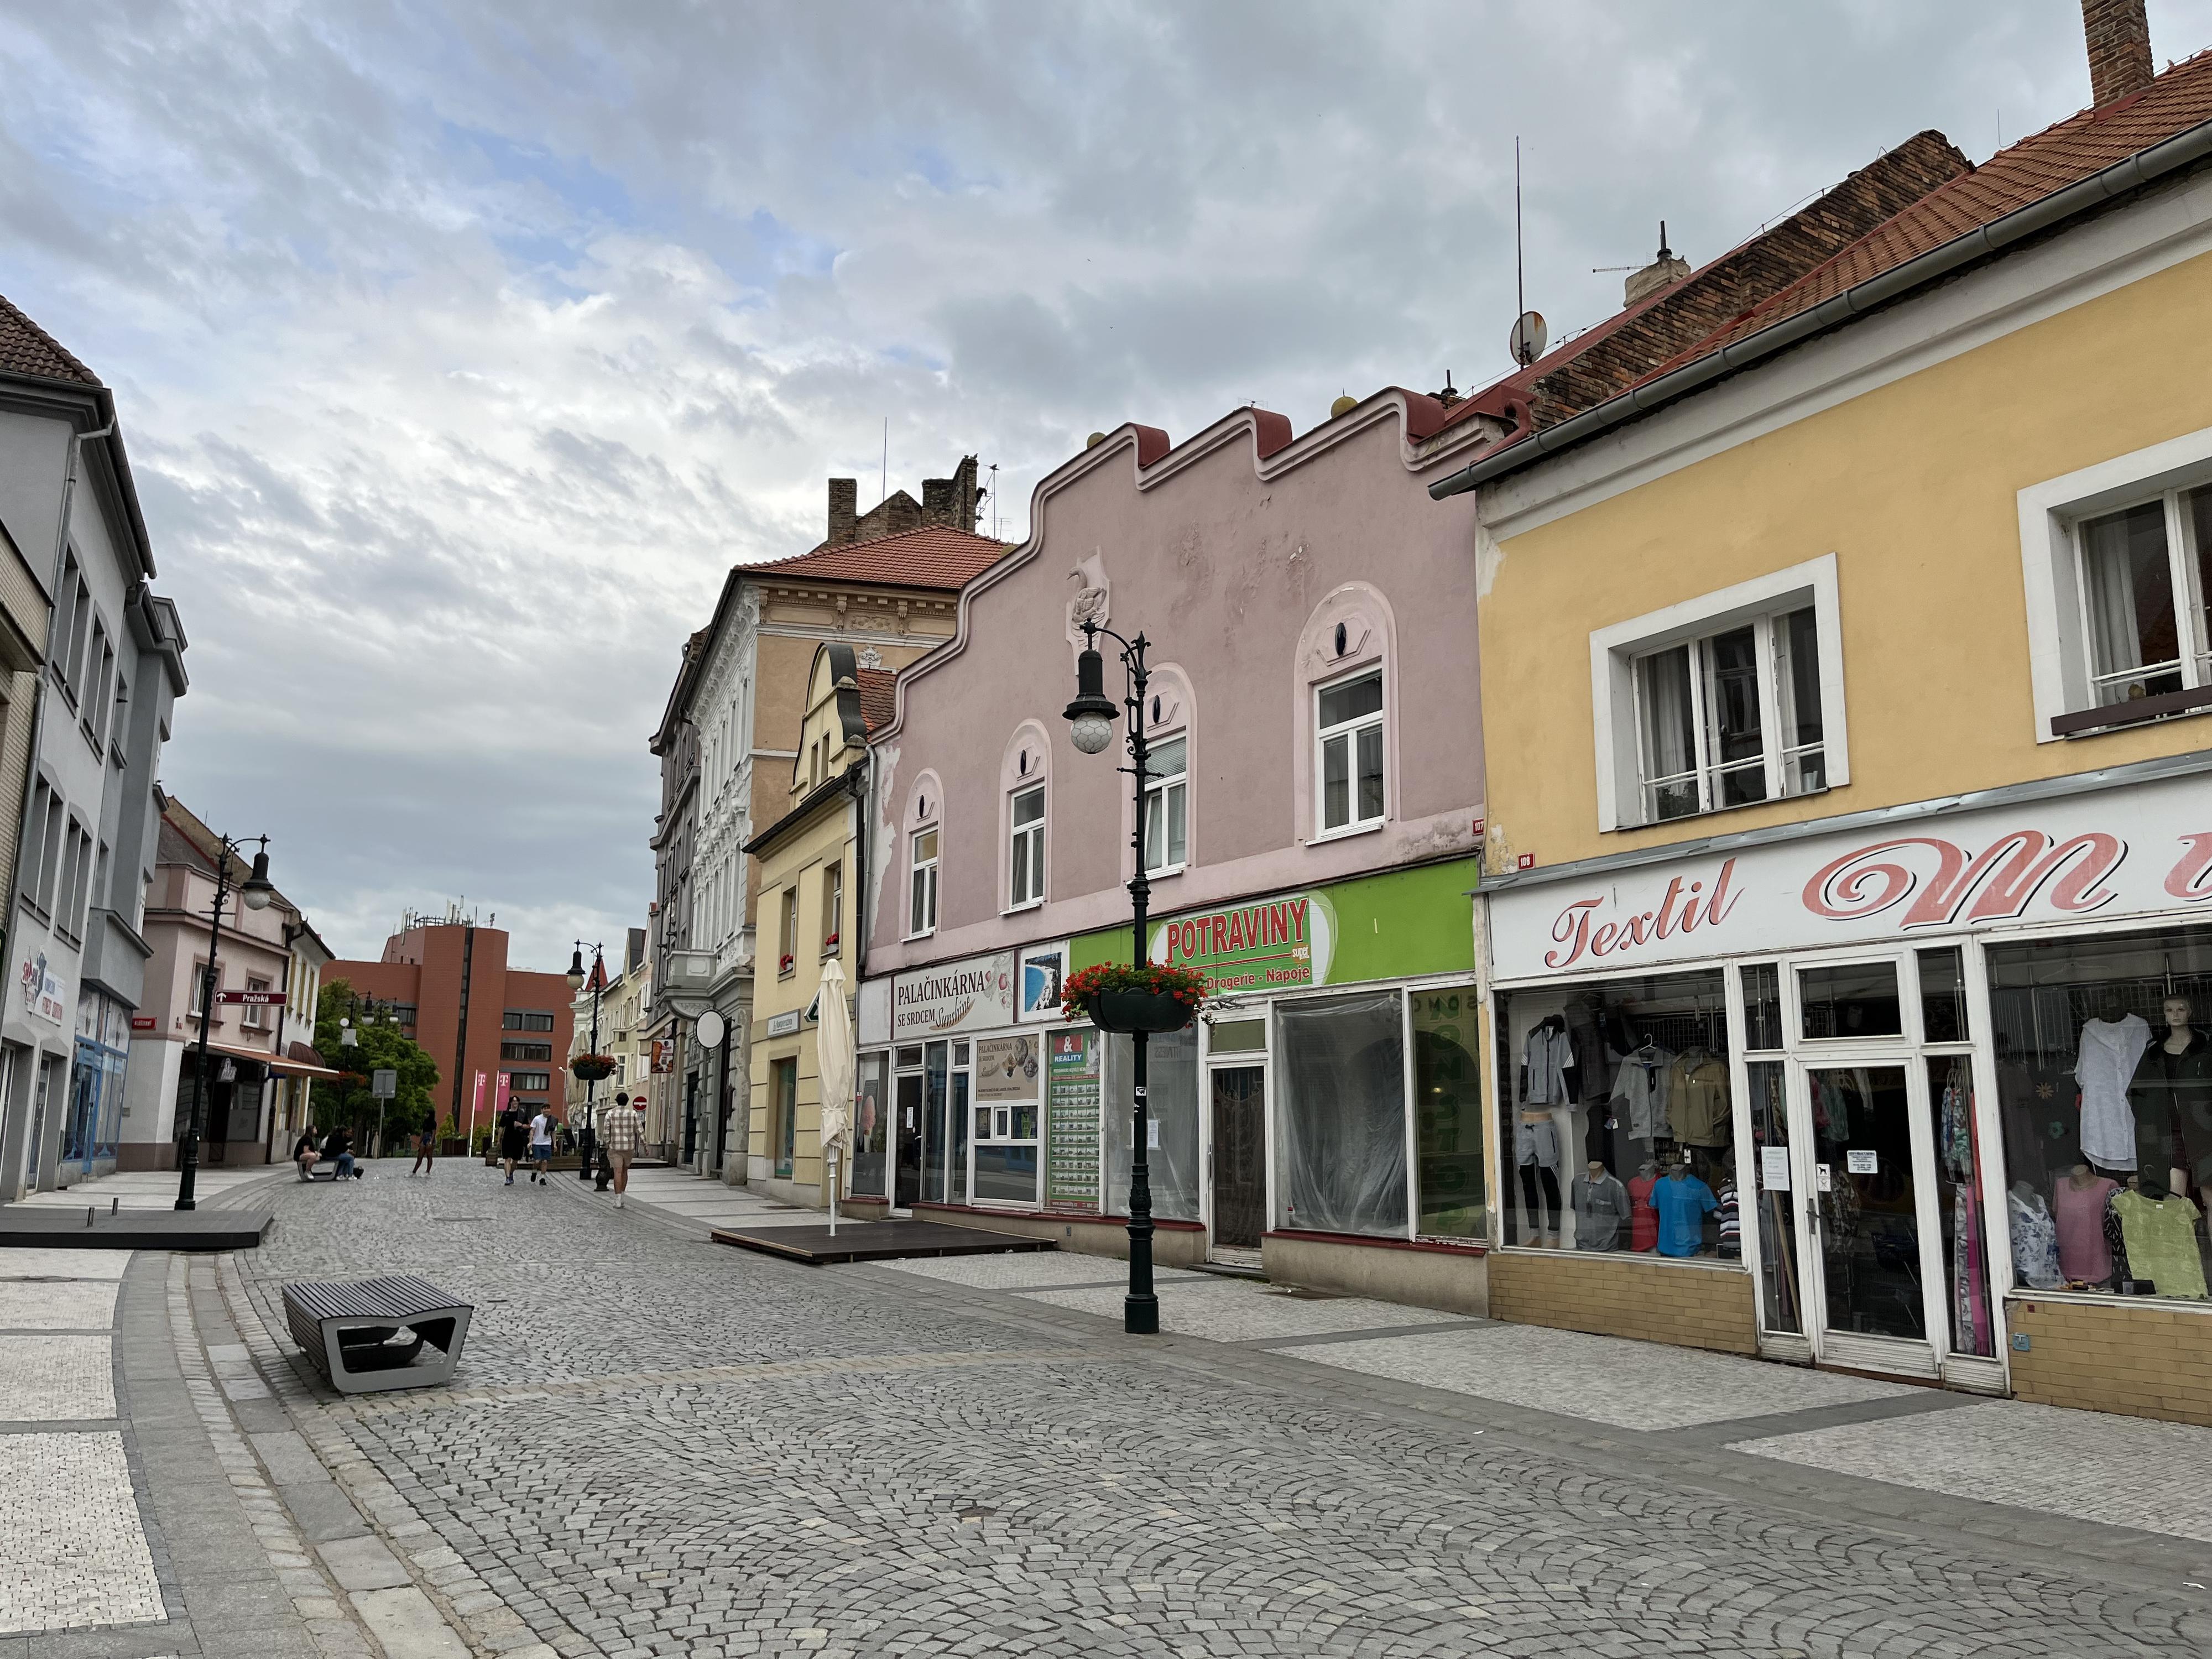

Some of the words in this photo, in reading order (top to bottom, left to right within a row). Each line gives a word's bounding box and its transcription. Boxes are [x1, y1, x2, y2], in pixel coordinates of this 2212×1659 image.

[1475, 821, 1484, 831] 107
[1520, 855, 1530, 867] 108
[1544, 857, 1745, 968] Textil
[1167, 897, 1309, 962] POTRAVINY
[1206, 971, 1255, 991] Drogerie
[1266, 964, 1311, 984] Nápoje
[898, 969, 985, 1006] PALAČINKÁRNA
[242, 994, 269, 1003] Pražská
[898, 1013, 906, 1027] SE
[907, 1008, 935, 1026] SRDCEM
[935, 995, 971, 1028] Sunshine
[978, 1042, 1013, 1053] PALAČINKÁRNA
[1054, 1054, 1082, 1062] REALITY
[499, 1074, 509, 1087] T
